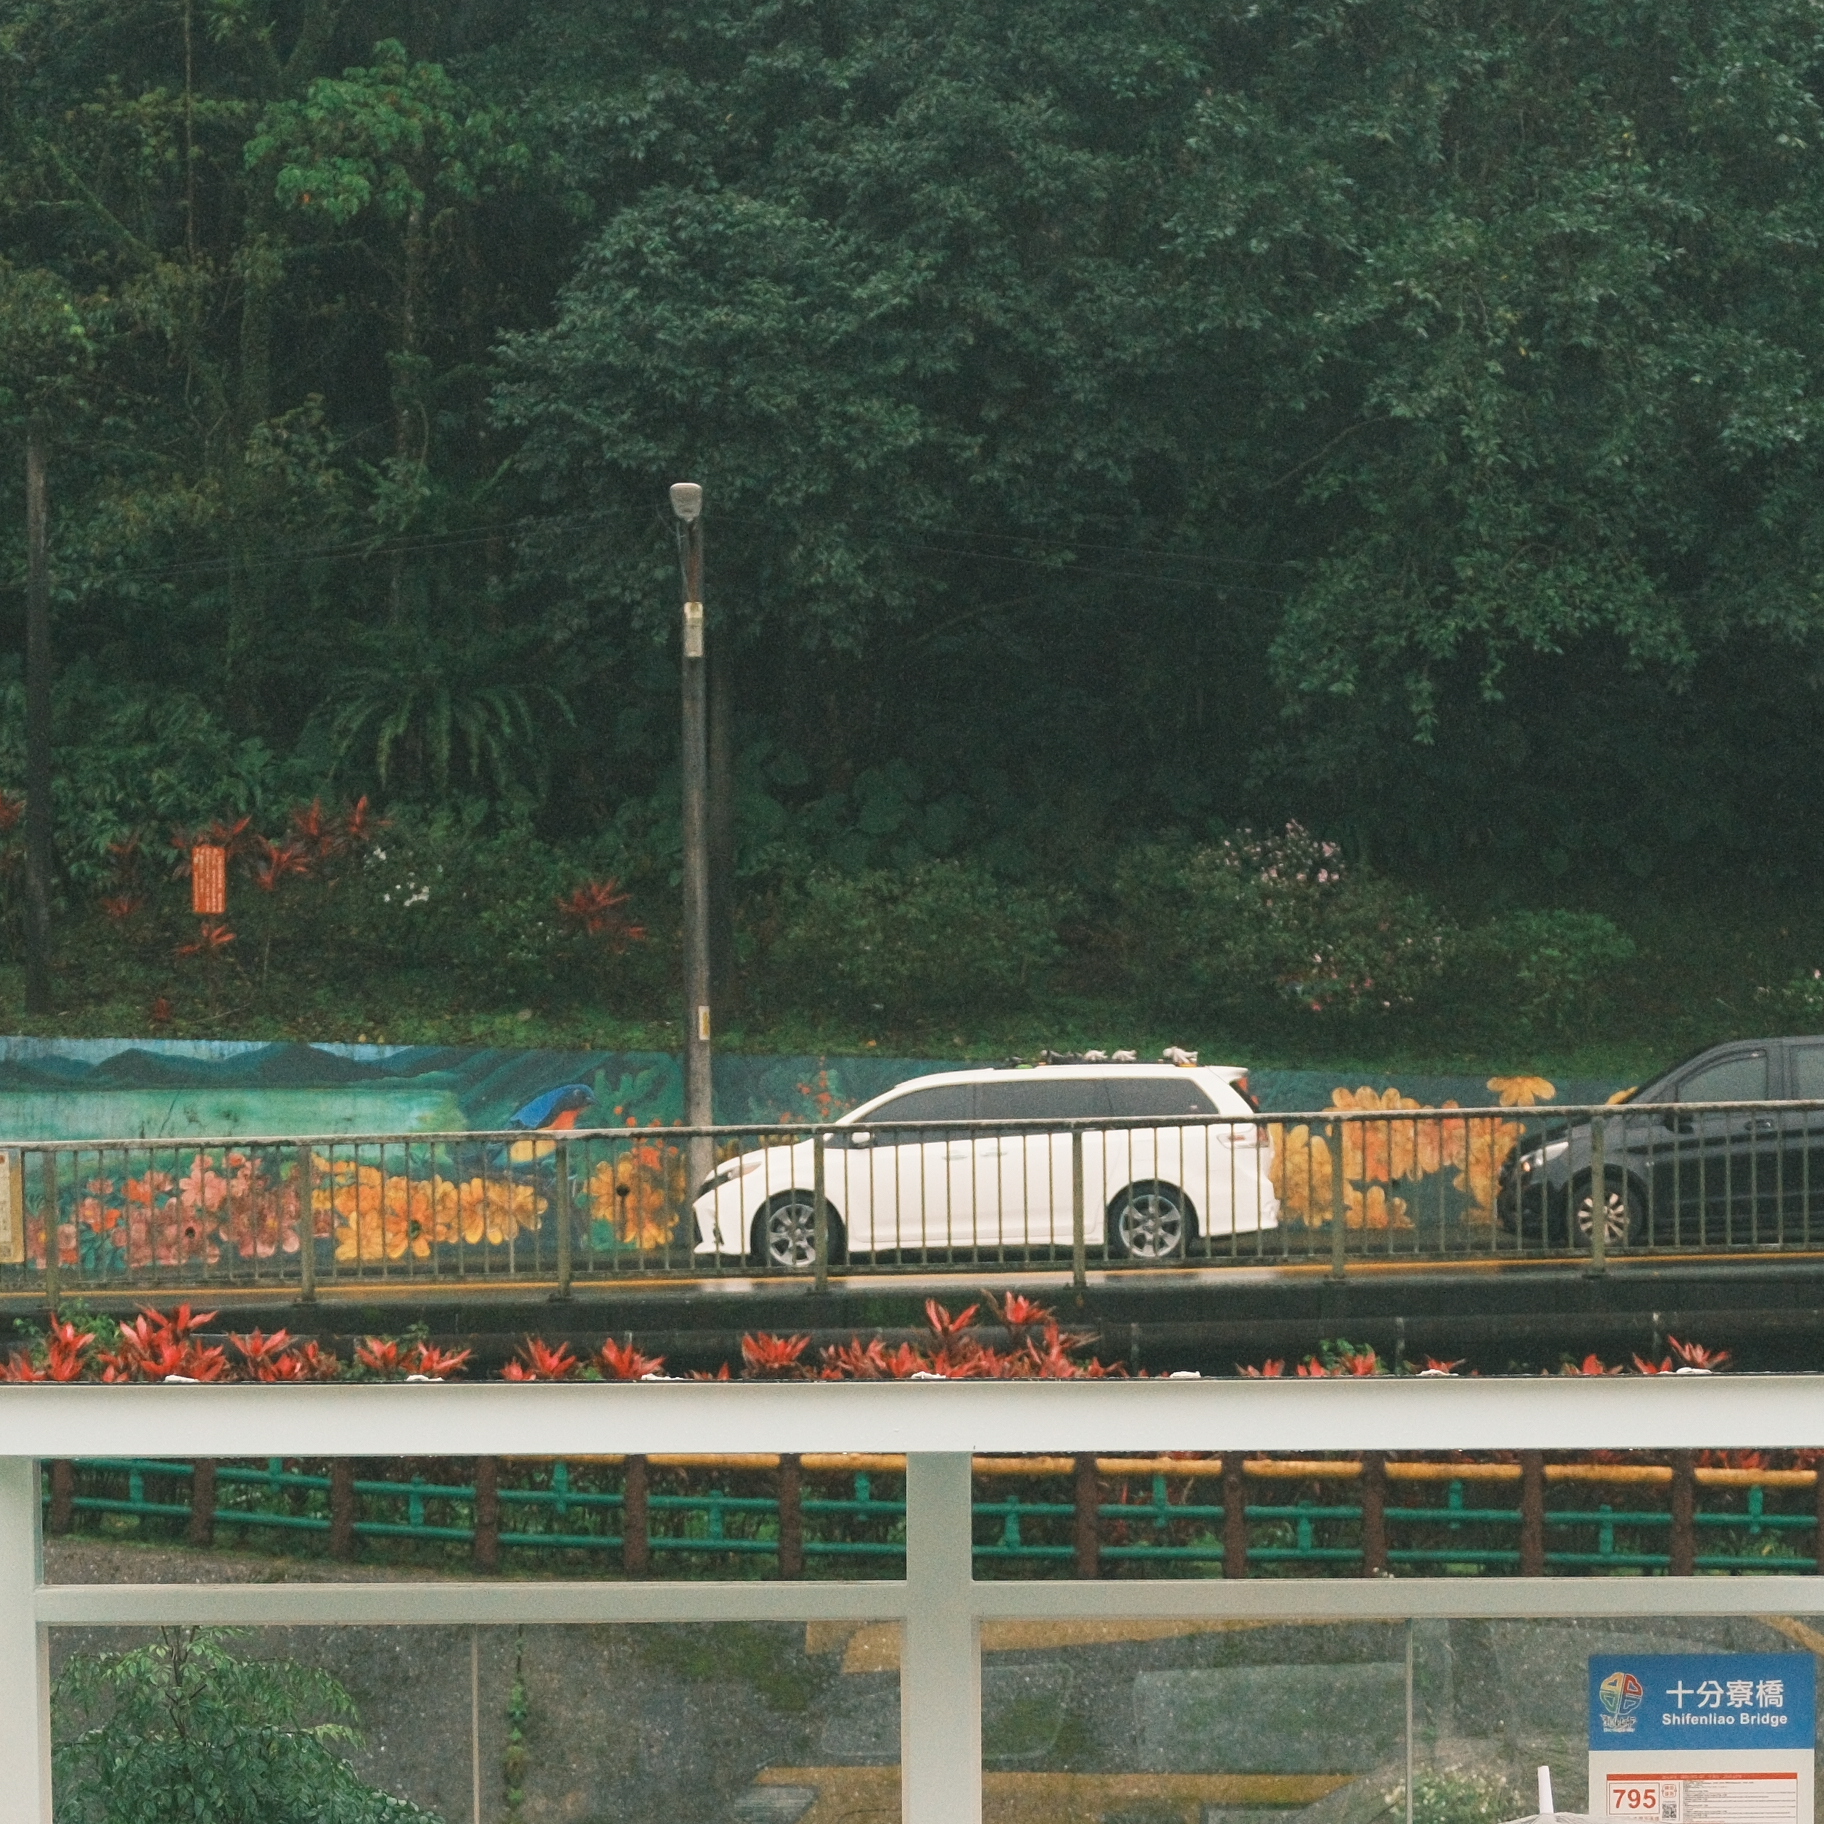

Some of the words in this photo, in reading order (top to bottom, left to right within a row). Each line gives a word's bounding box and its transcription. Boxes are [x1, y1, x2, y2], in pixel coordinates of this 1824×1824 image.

[1665, 1679, 1784, 1709] 十分寮橋
[1662, 1712, 1735, 1725] Shifenliao
[1740, 1713, 1788, 1727] Bridge
[1612, 1788, 1657, 1809] 795
